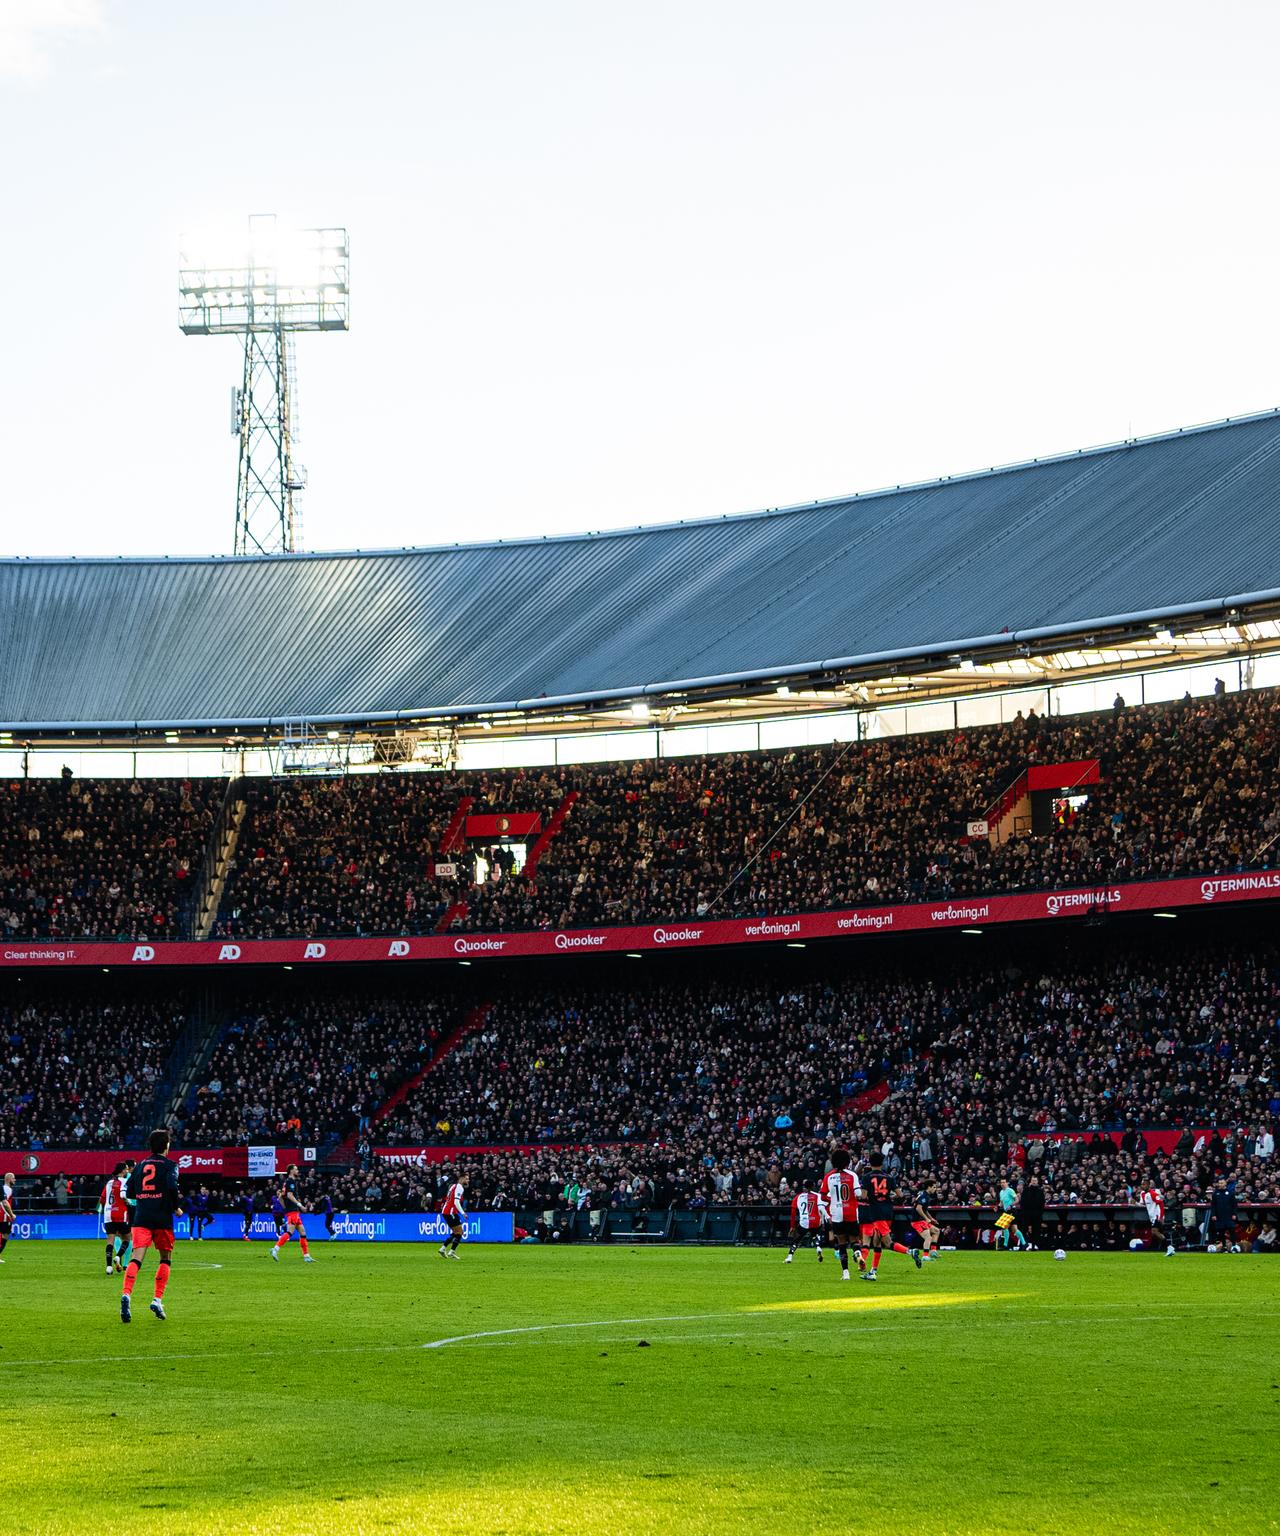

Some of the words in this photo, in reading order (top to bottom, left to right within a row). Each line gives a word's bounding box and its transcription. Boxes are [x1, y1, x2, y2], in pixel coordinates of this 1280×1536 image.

[972, 824, 984, 833] CC
[1201, 875, 1280, 899] QTERMINALS
[1047, 890, 1121, 914] QTERMINALS
[931, 904, 989, 921] verloning.nl
[837, 913, 893, 928] verloning.nl
[653, 928, 702, 943] Quooker
[745, 921, 800, 936] verloning.nl
[388, 941, 410, 956] AD
[454, 938, 505, 953] Quooker
[555, 934, 605, 949] Quooker
[4, 950, 28, 959] Clear
[29, 950, 65, 961] thinking
[132, 945, 155, 961] AD
[218, 945, 241, 960] AD
[303, 943, 326, 959] AD
[195, 1157, 215, 1166] Port
[142, 1163, 157, 1191] 2
[833, 1183, 851, 1202] 10
[870, 1177, 888, 1197] 14
[800, 1201, 816, 1216] 27
